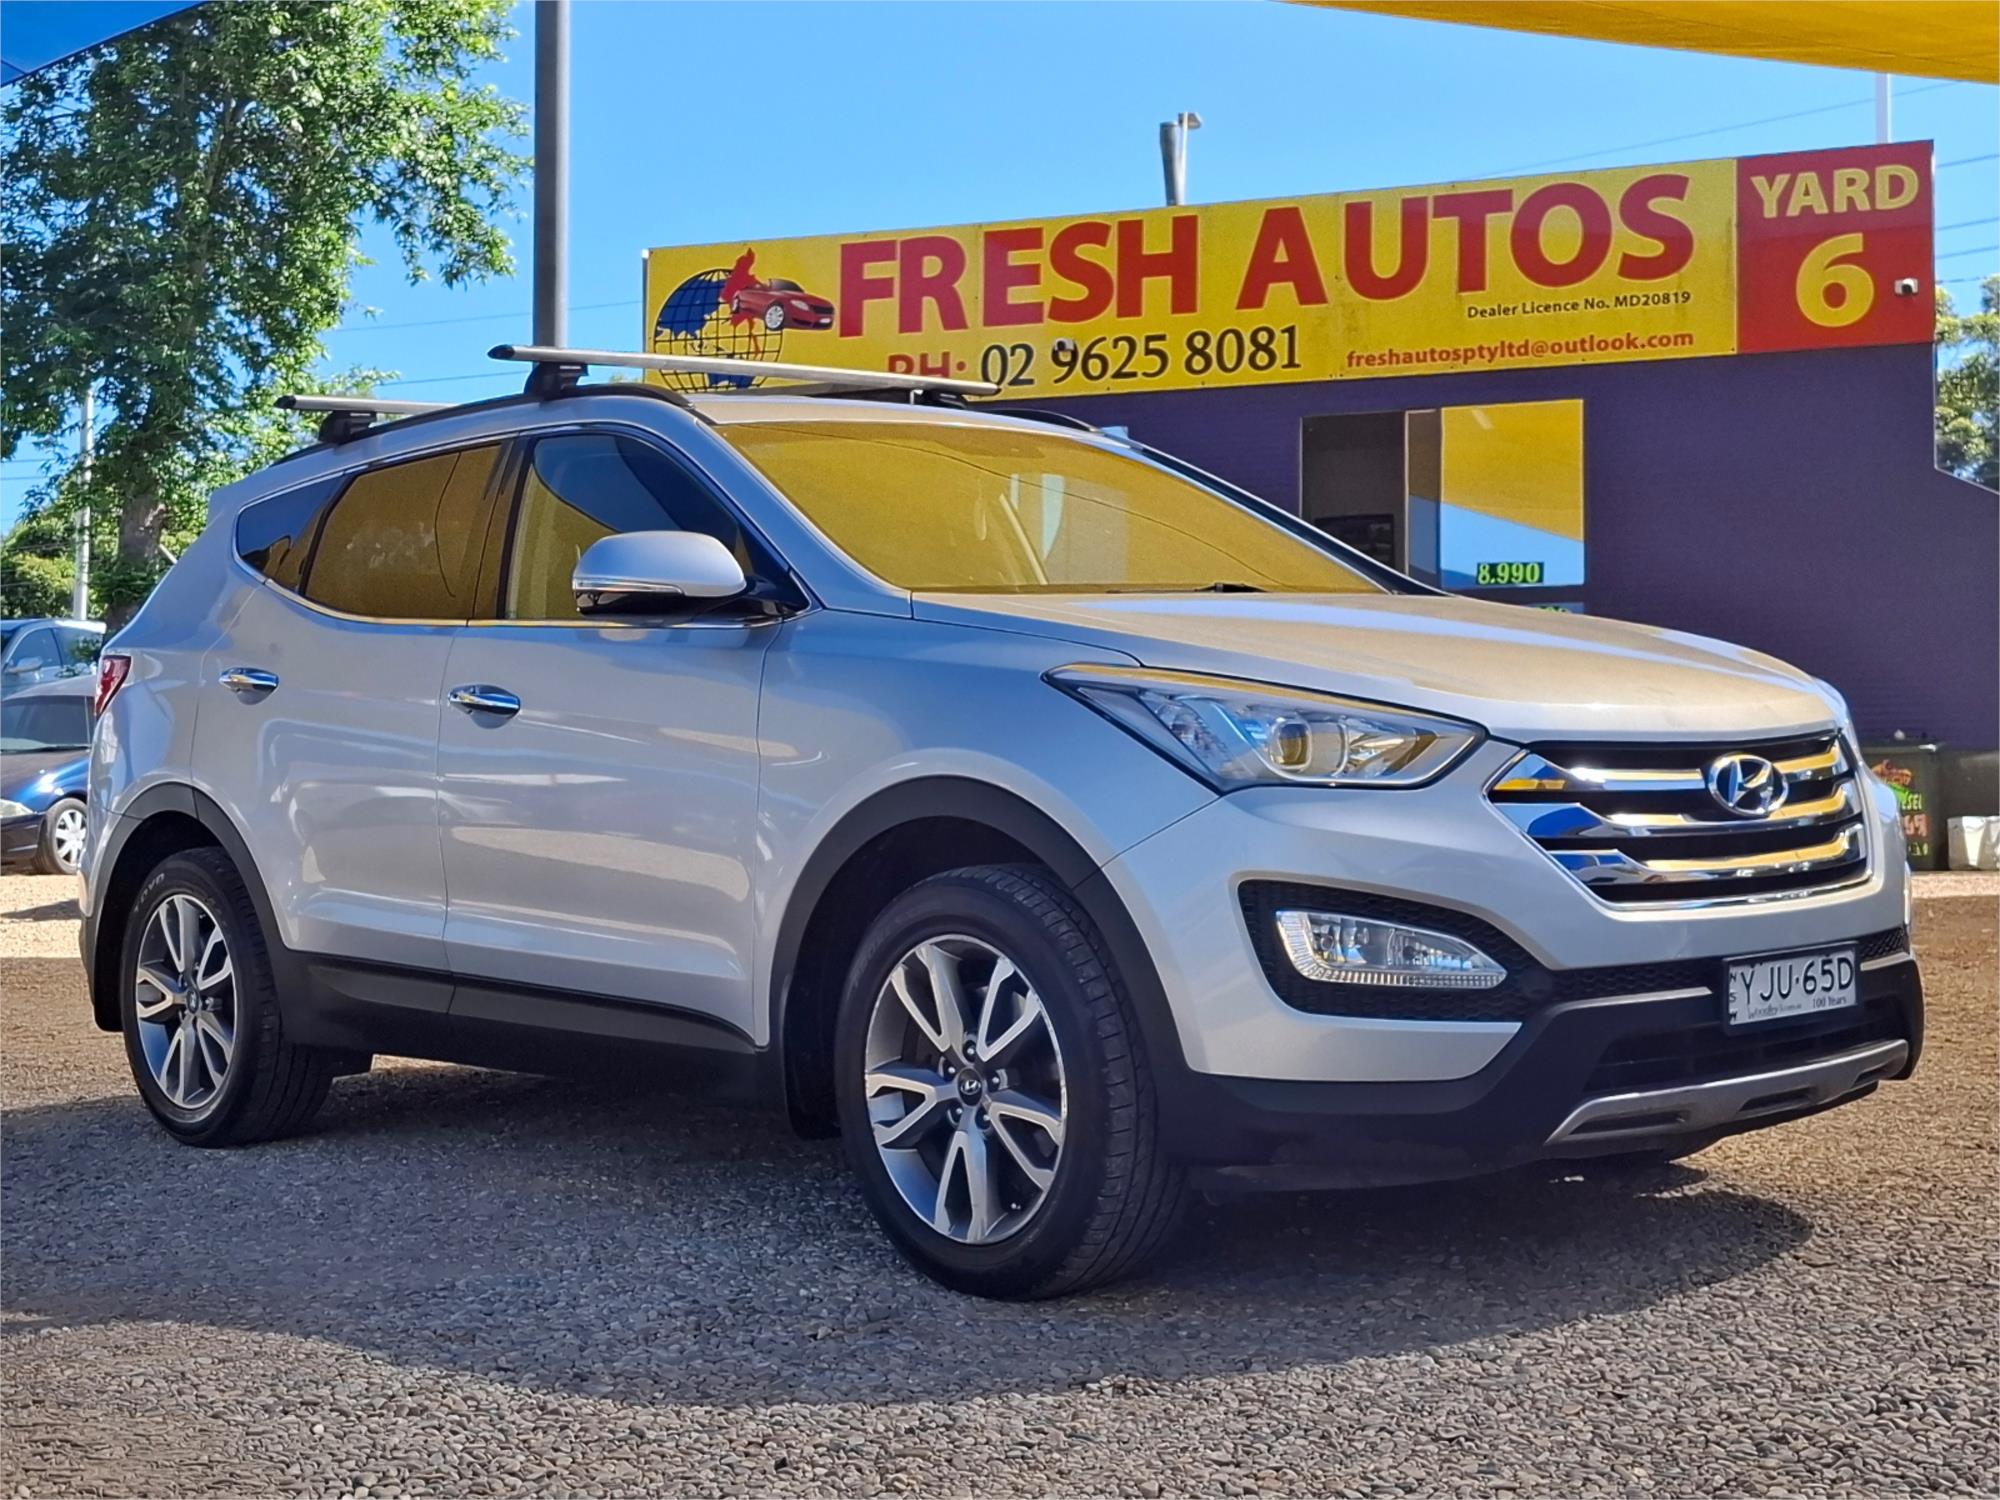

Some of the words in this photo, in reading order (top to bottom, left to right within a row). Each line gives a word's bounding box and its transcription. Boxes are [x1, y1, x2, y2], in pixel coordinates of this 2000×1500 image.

[1750, 164, 1919, 219] YARD
[838, 214, 1199, 338] FRESH
[1234, 175, 1694, 311] AUTOS
[1796, 232, 1874, 327] 6
[1466, 303, 1518, 319] Dealer
[1521, 299, 1580, 316] Licence
[1583, 297, 1611, 310] No.
[1613, 290, 1692, 308] MD20819
[981, 343, 1035, 387] 02
[1050, 334, 1170, 384] 9625
[1184, 324, 1302, 376] 8081
[1346, 332, 1694, 368] freshautosptyltd@outlook.com
[1477, 562, 1541, 585] 8.990
